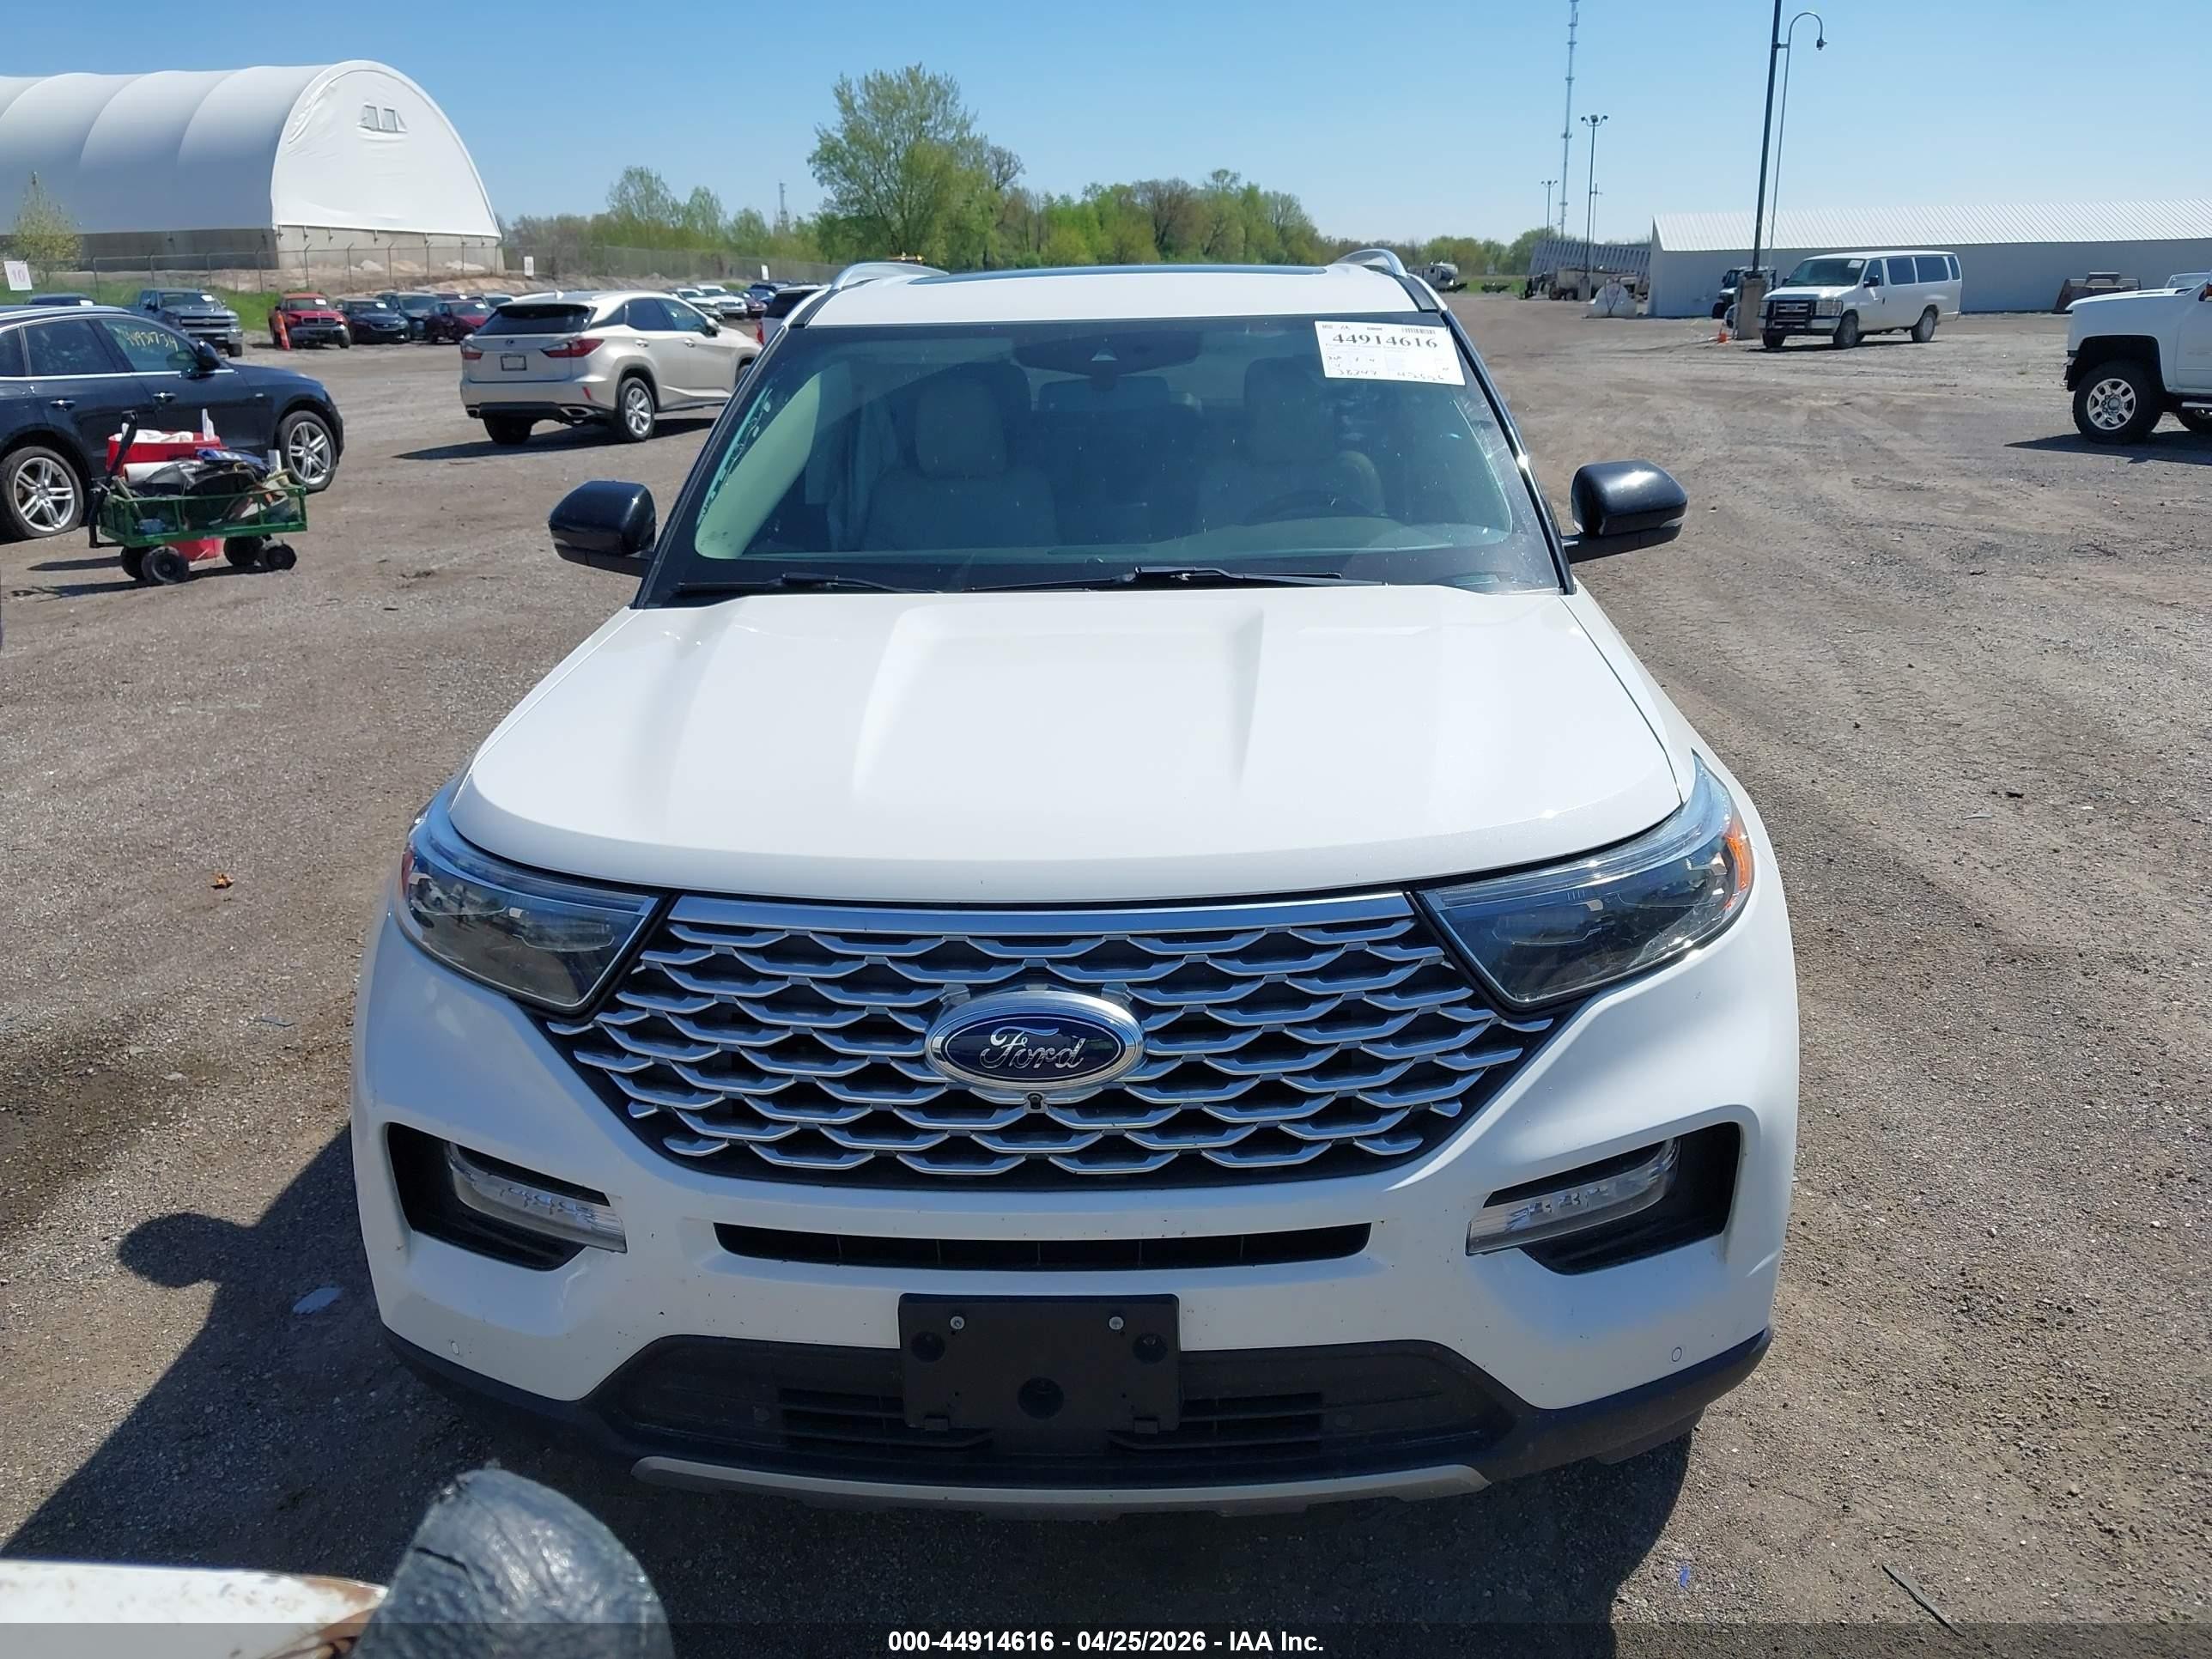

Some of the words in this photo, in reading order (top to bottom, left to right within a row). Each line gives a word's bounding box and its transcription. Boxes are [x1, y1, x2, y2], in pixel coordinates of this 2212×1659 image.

[11, 269, 26, 283] 10
[1333, 333, 1437, 349] 44914616
[980, 1025, 1086, 1070] Ford
